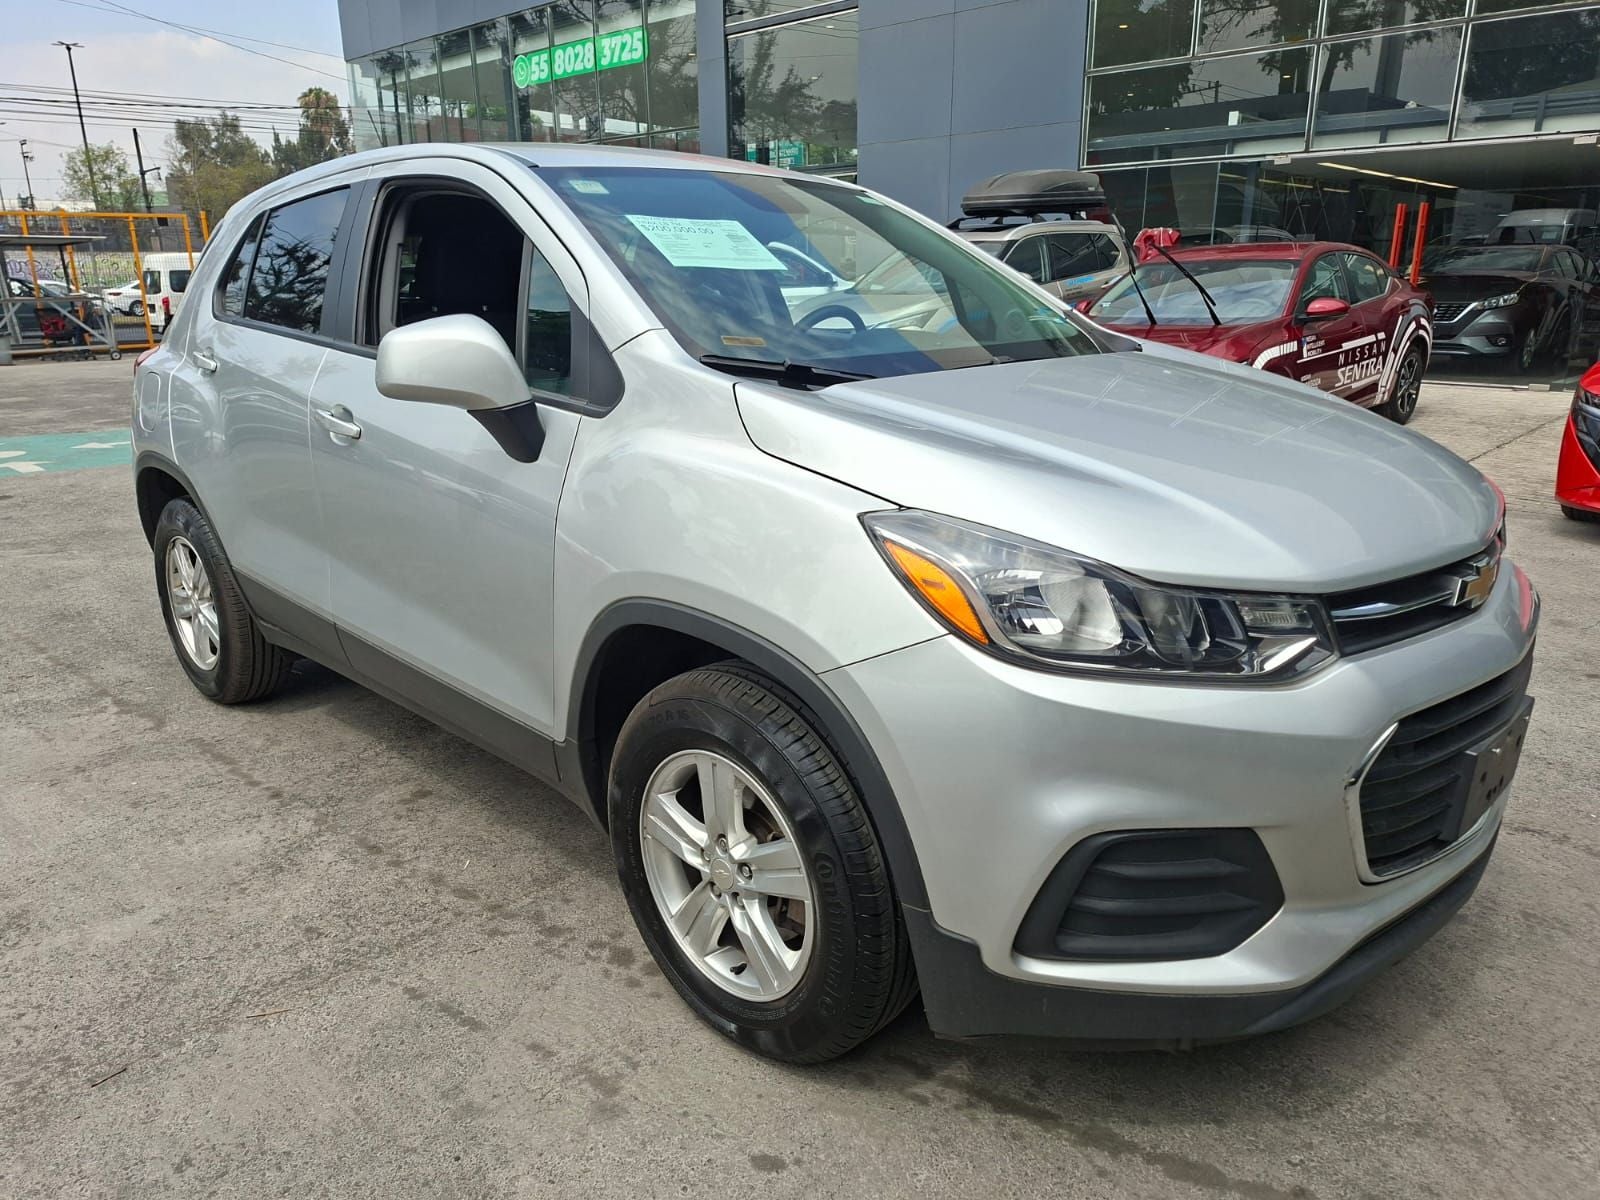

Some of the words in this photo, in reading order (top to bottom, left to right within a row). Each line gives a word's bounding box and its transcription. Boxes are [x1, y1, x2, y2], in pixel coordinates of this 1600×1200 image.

[530, 53, 549, 81] 55
[554, 42, 595, 75] 8028
[600, 30, 643, 66] 3725
[1338, 340, 1386, 366] NISSAN
[1335, 355, 1383, 387] SENTRA
